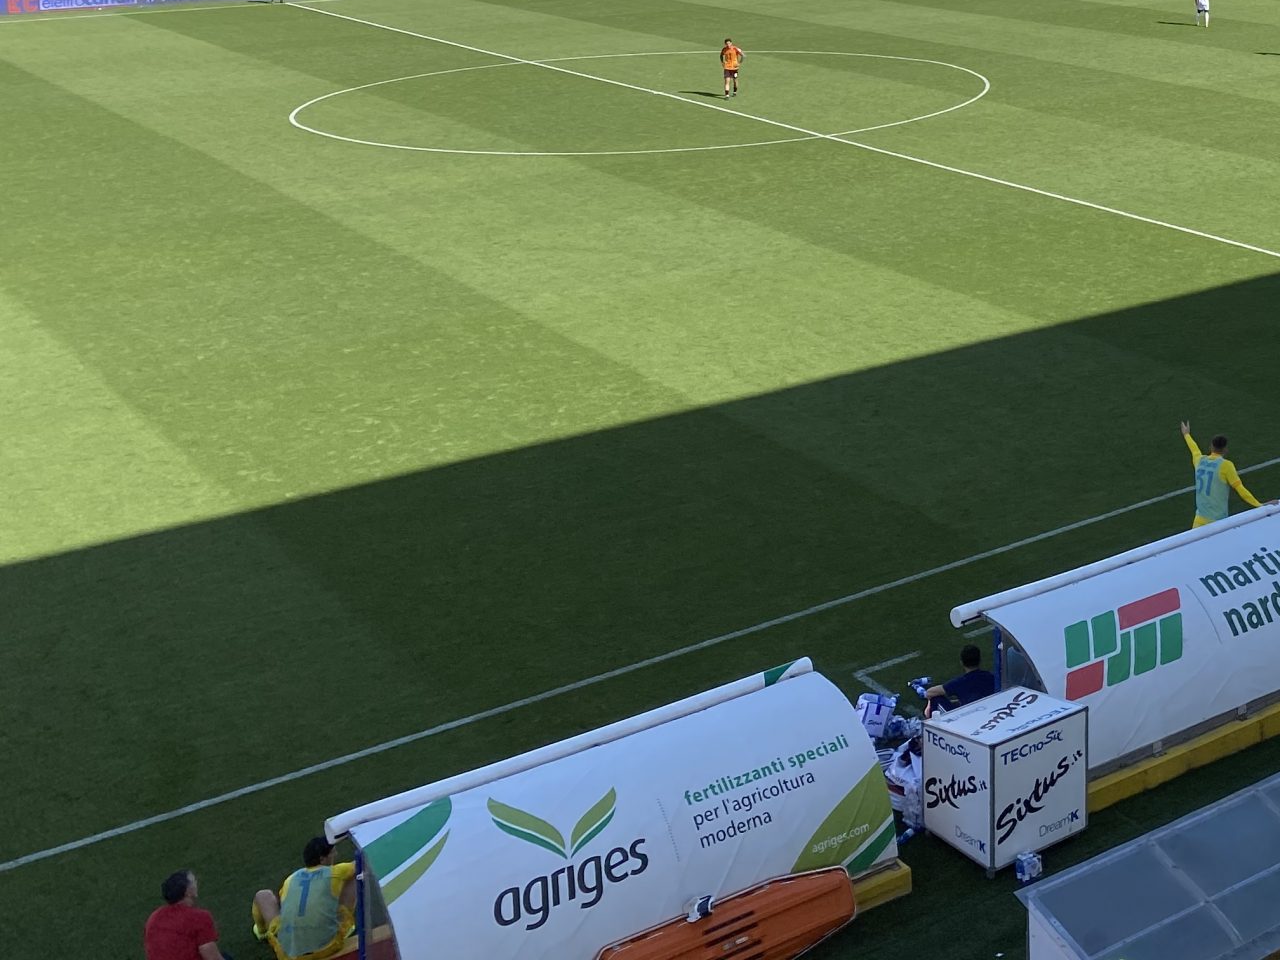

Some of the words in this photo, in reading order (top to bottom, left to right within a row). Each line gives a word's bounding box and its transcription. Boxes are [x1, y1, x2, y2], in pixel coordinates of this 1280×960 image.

[683, 757, 785, 807] fertilizzanti
[789, 734, 849, 769] speciali
[693, 805, 720, 831] per
[722, 769, 816, 814] l'agricoltura
[699, 809, 773, 850] moderna
[811, 822, 870, 855] agriges.com
[493, 838, 649, 931] agriges
